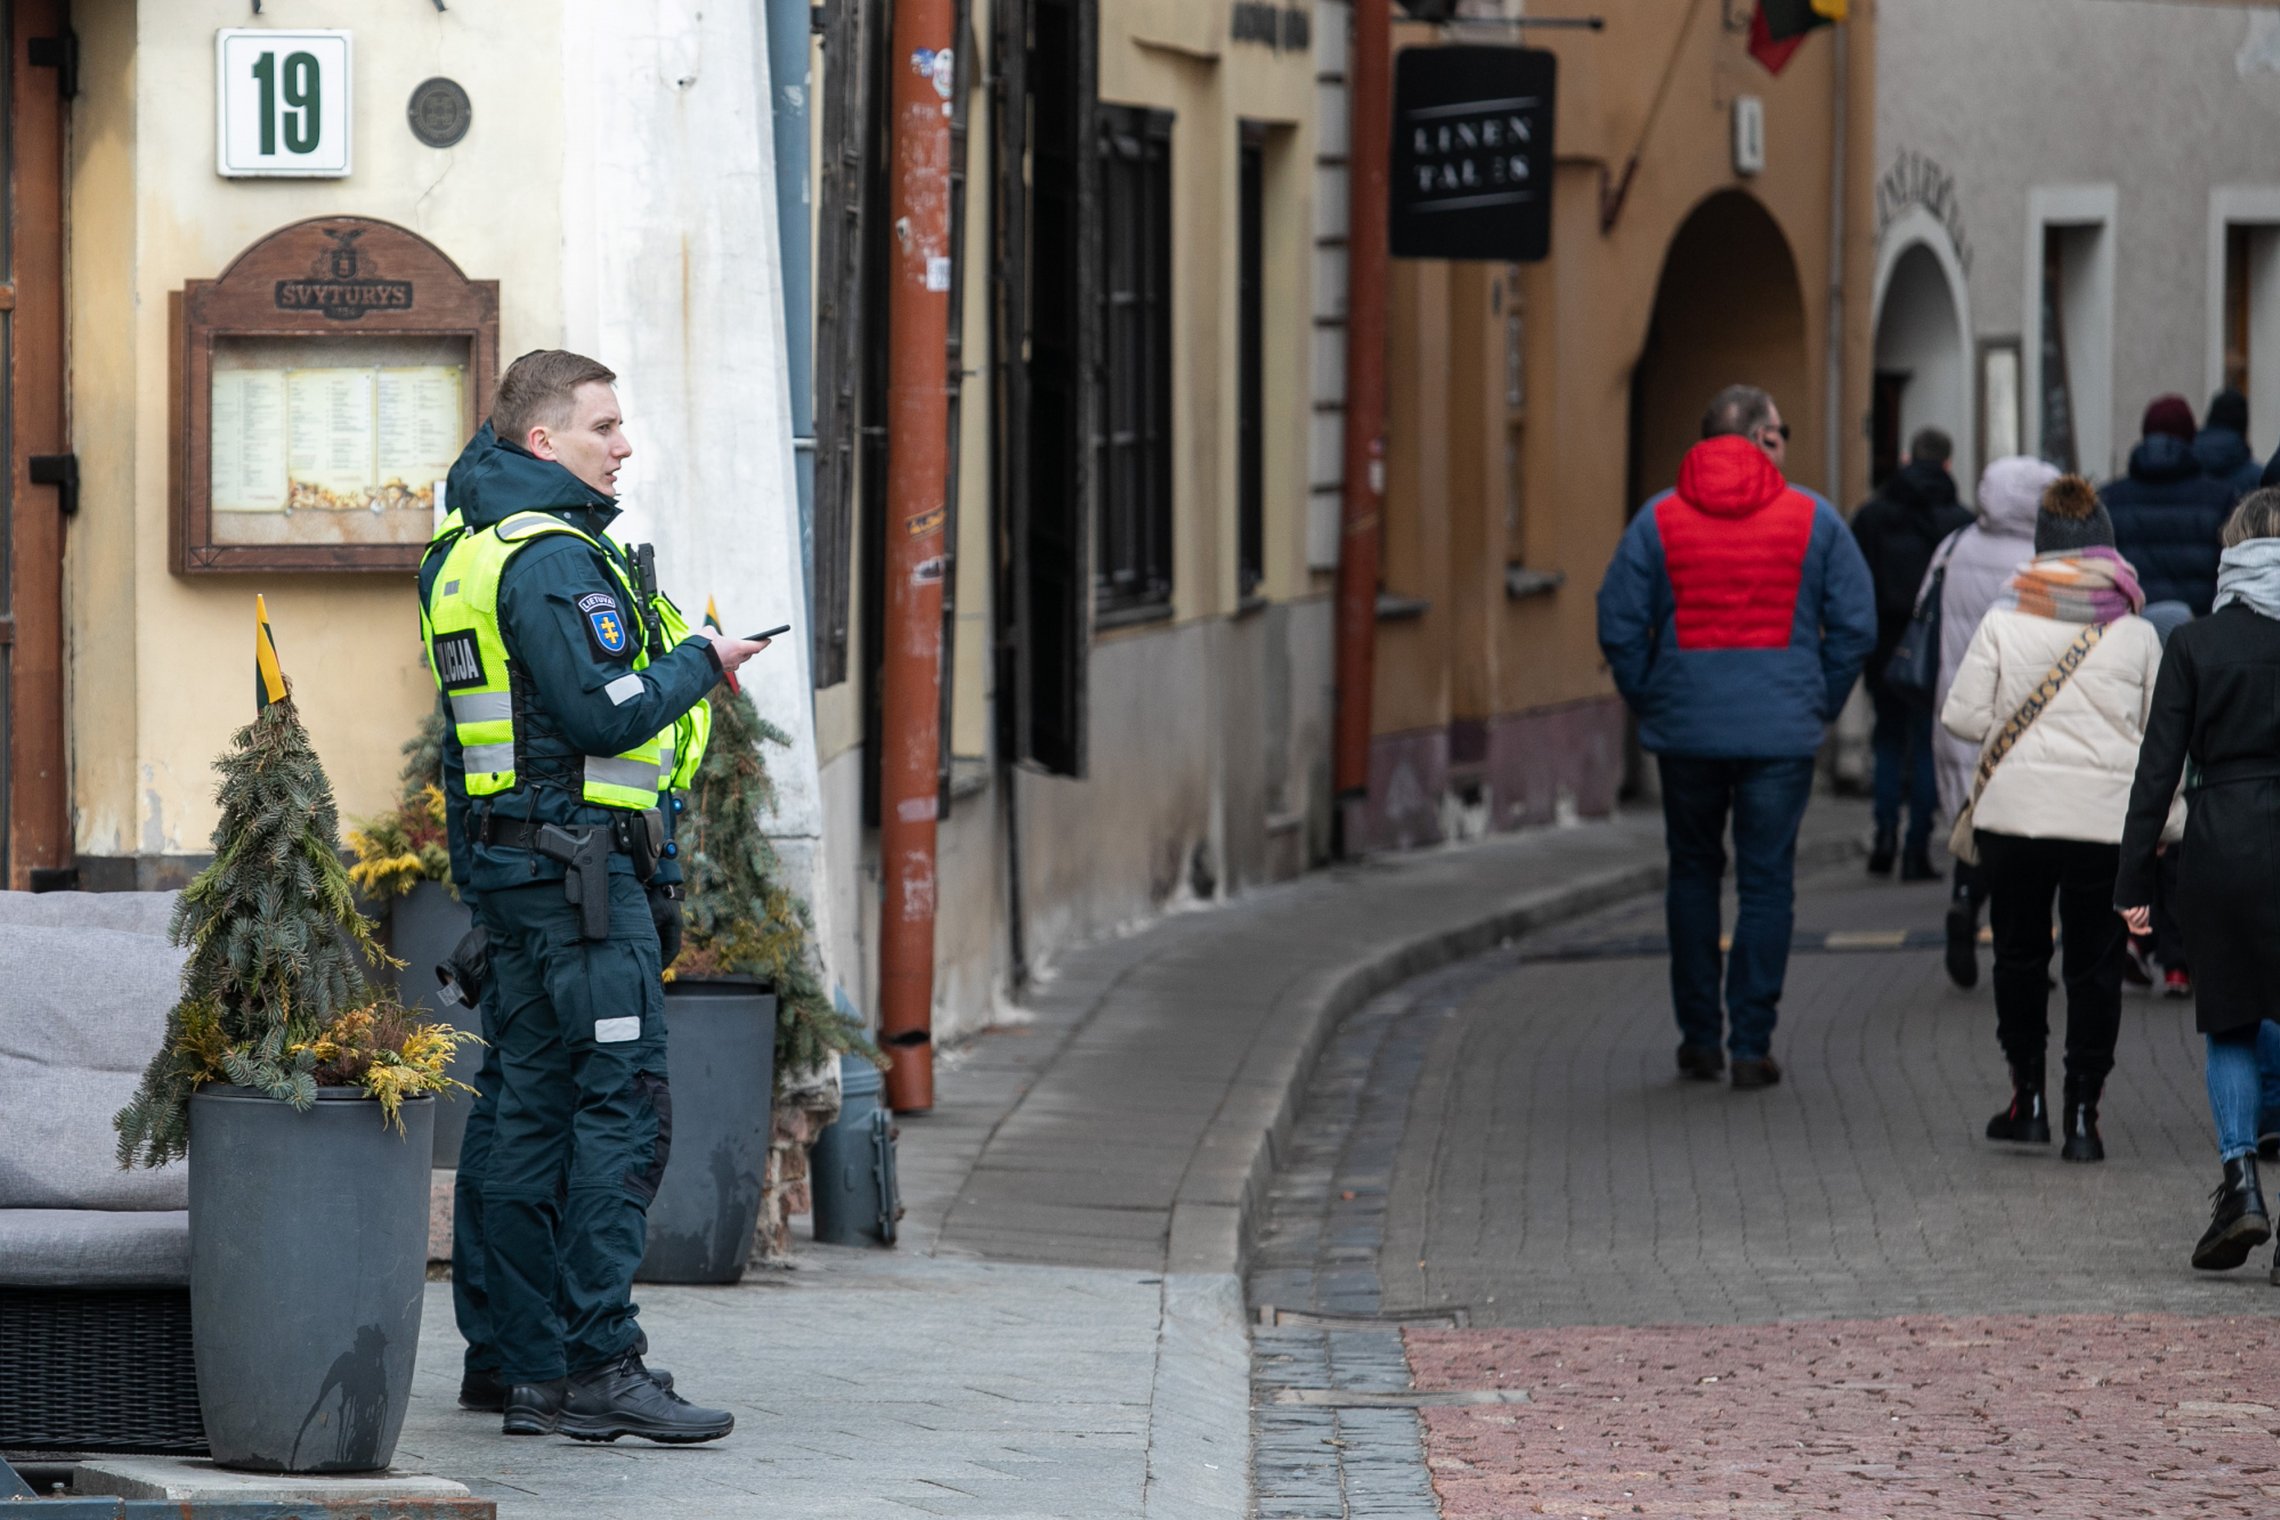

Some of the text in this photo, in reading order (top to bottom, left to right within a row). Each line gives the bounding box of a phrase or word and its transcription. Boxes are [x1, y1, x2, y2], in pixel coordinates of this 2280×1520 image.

[251, 51, 321, 155] 19
[1414, 116, 1532, 154] LINEN
[1413, 153, 1531, 192] TALES
[582, 596, 613, 609] LIETUVA
[437, 638, 480, 683] LICIJA
